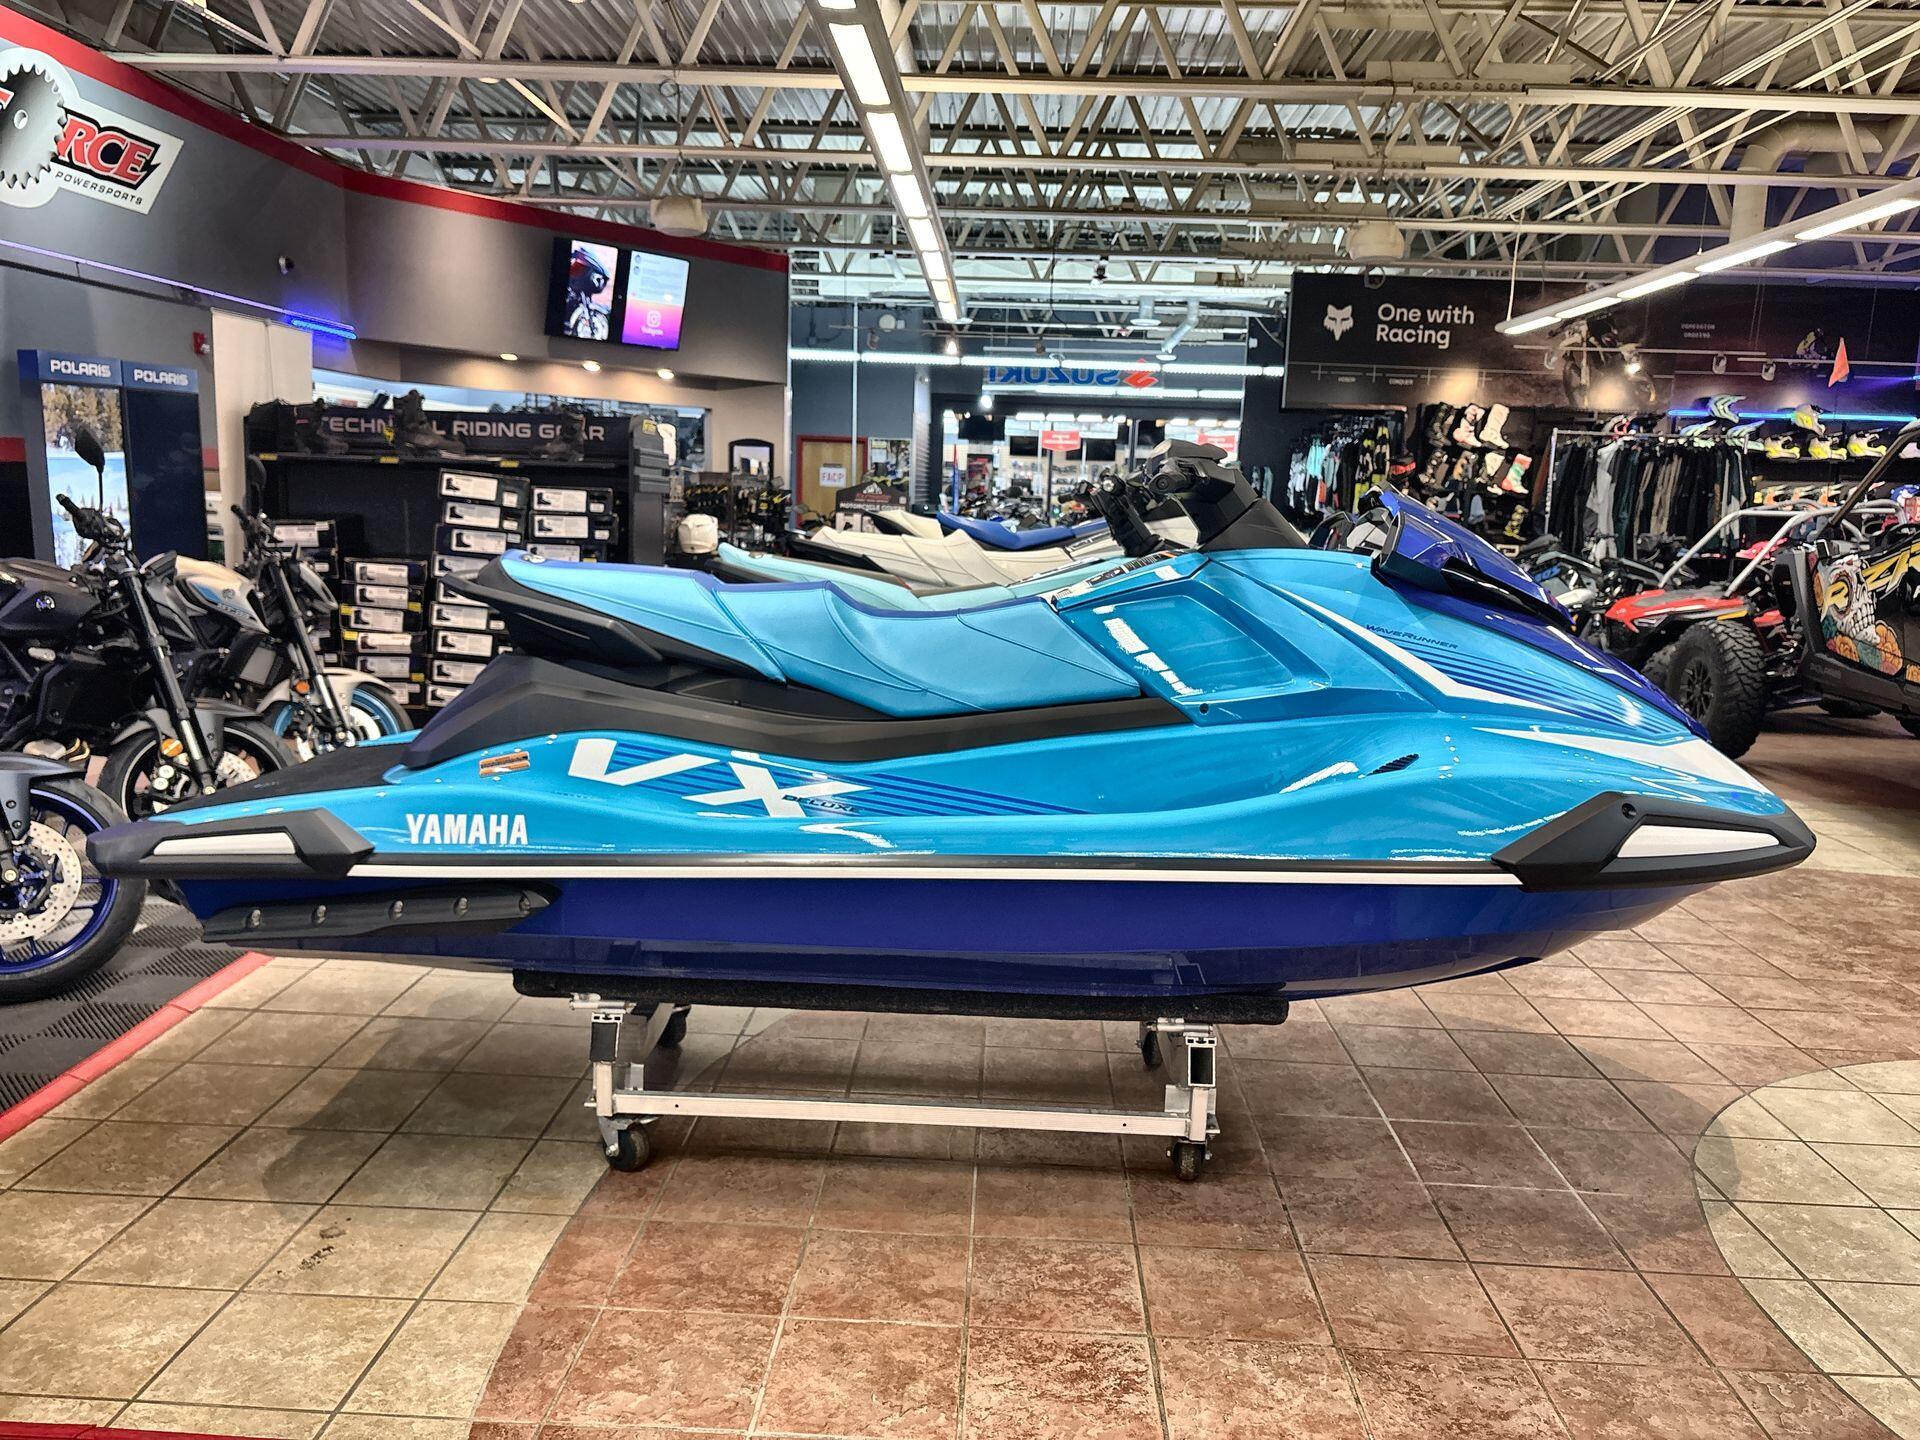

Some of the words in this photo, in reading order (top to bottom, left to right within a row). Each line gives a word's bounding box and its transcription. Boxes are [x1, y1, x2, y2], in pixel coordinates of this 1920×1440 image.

[54, 170, 143, 206] POWERSPORTS
[1377, 302, 1422, 323] One
[1426, 304, 1475, 325] with
[1375, 324, 1451, 350] Racing
[50, 359, 112, 379] POLARIS
[133, 368, 189, 386] POLARIS
[452, 420, 532, 439] RIDING
[538, 423, 606, 442] GR
[1365, 624, 1459, 650] WAVERUNNER
[568, 738, 873, 818] VX
[781, 794, 861, 814] DELUXE
[405, 813, 529, 845] YAMAHA
